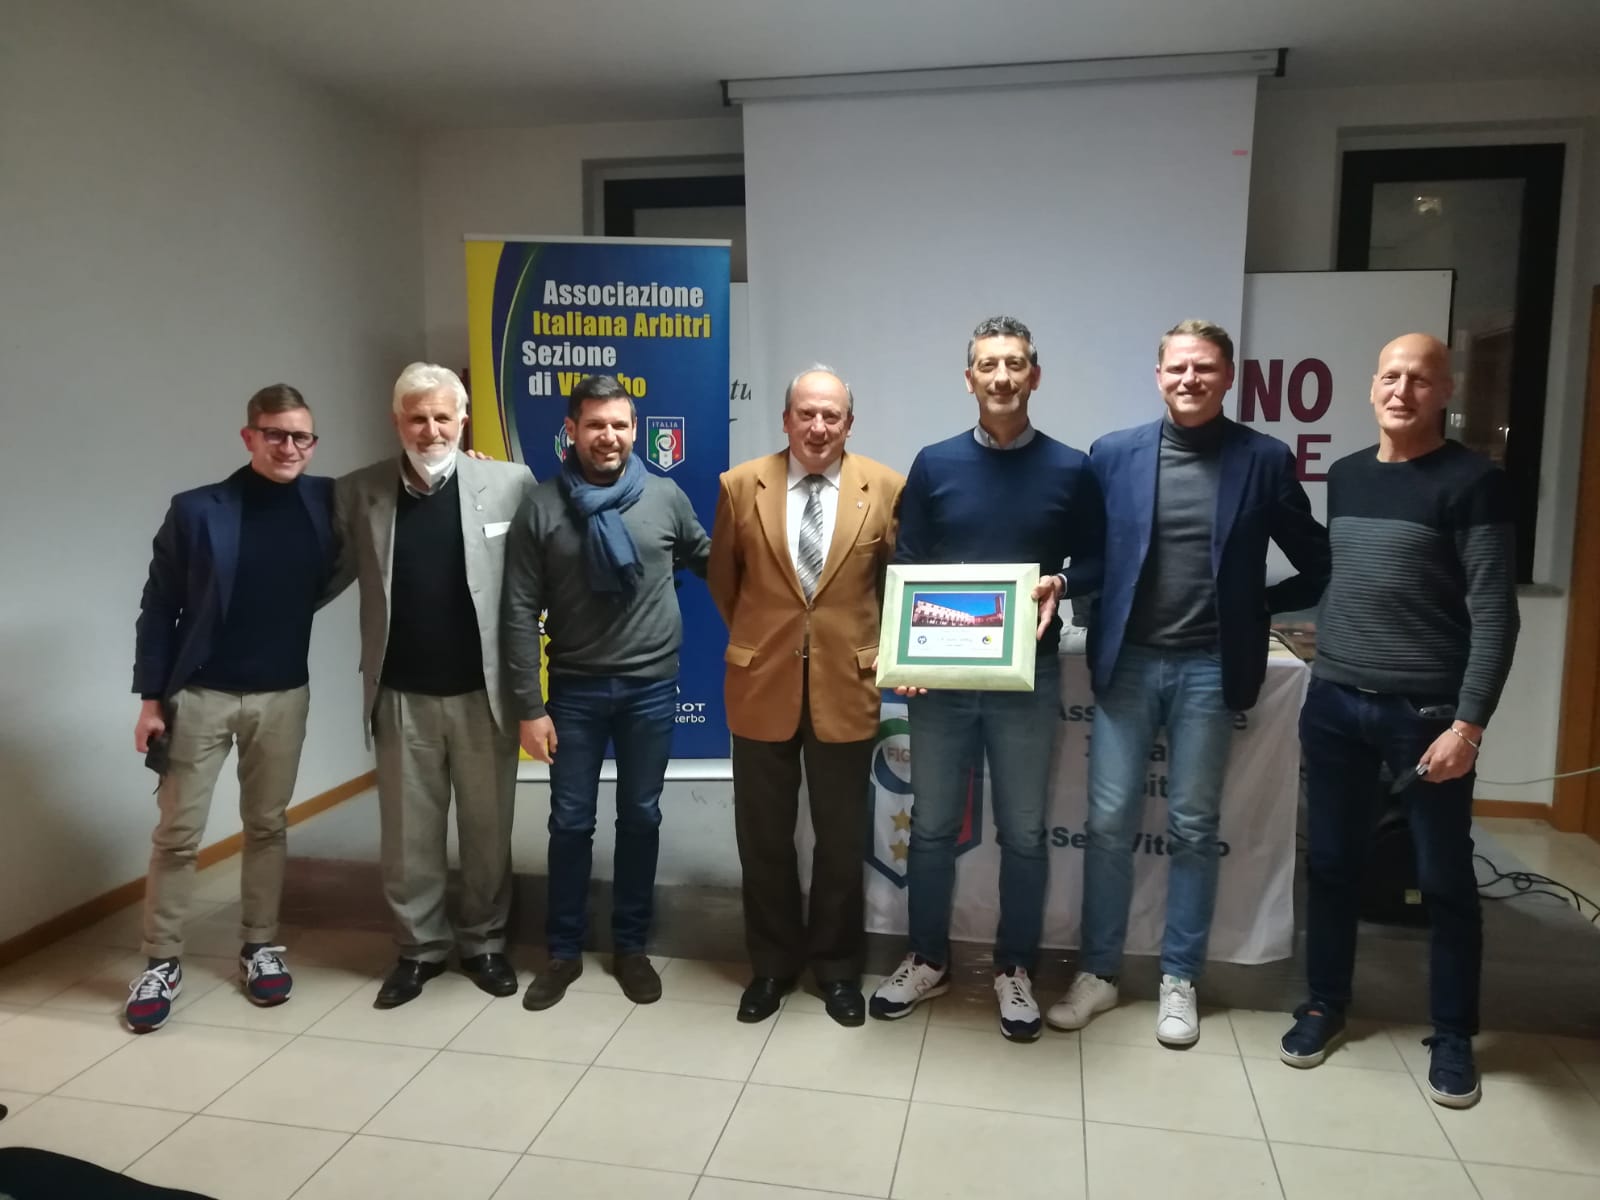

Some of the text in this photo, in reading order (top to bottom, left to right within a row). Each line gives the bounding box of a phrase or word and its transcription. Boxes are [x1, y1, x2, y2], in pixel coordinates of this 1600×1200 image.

[543, 280, 704, 307] Associazione
[533, 310, 711, 338] Italiana Arbitri
[522, 340, 617, 367] Sezione
[528, 371, 647, 398] di Vibo
[1240, 358, 1333, 423] NO
